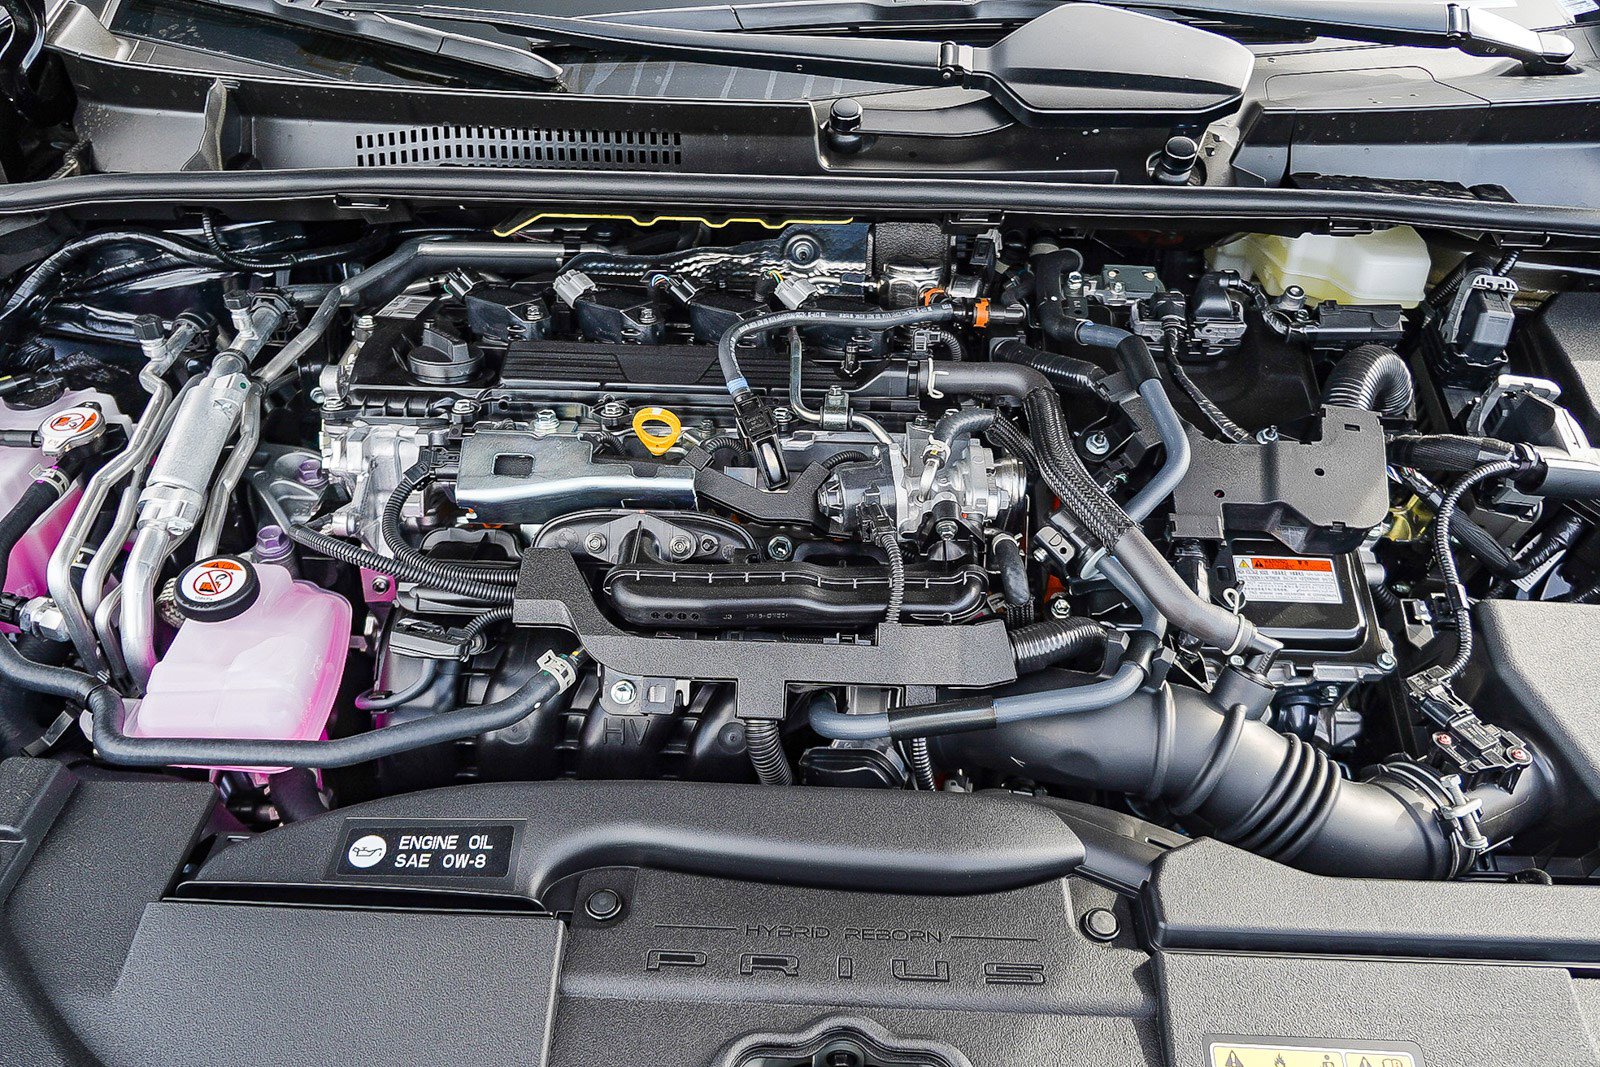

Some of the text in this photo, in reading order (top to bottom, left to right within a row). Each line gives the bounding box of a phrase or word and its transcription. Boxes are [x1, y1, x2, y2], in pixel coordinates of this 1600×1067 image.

[603, 717, 651, 746] HV
[398, 835, 494, 849] ENGINE OIL
[394, 853, 486, 868] SAE 0W-8
[744, 923, 943, 944] HYBRID REBORN
[645, 950, 1046, 985] PRIUS
